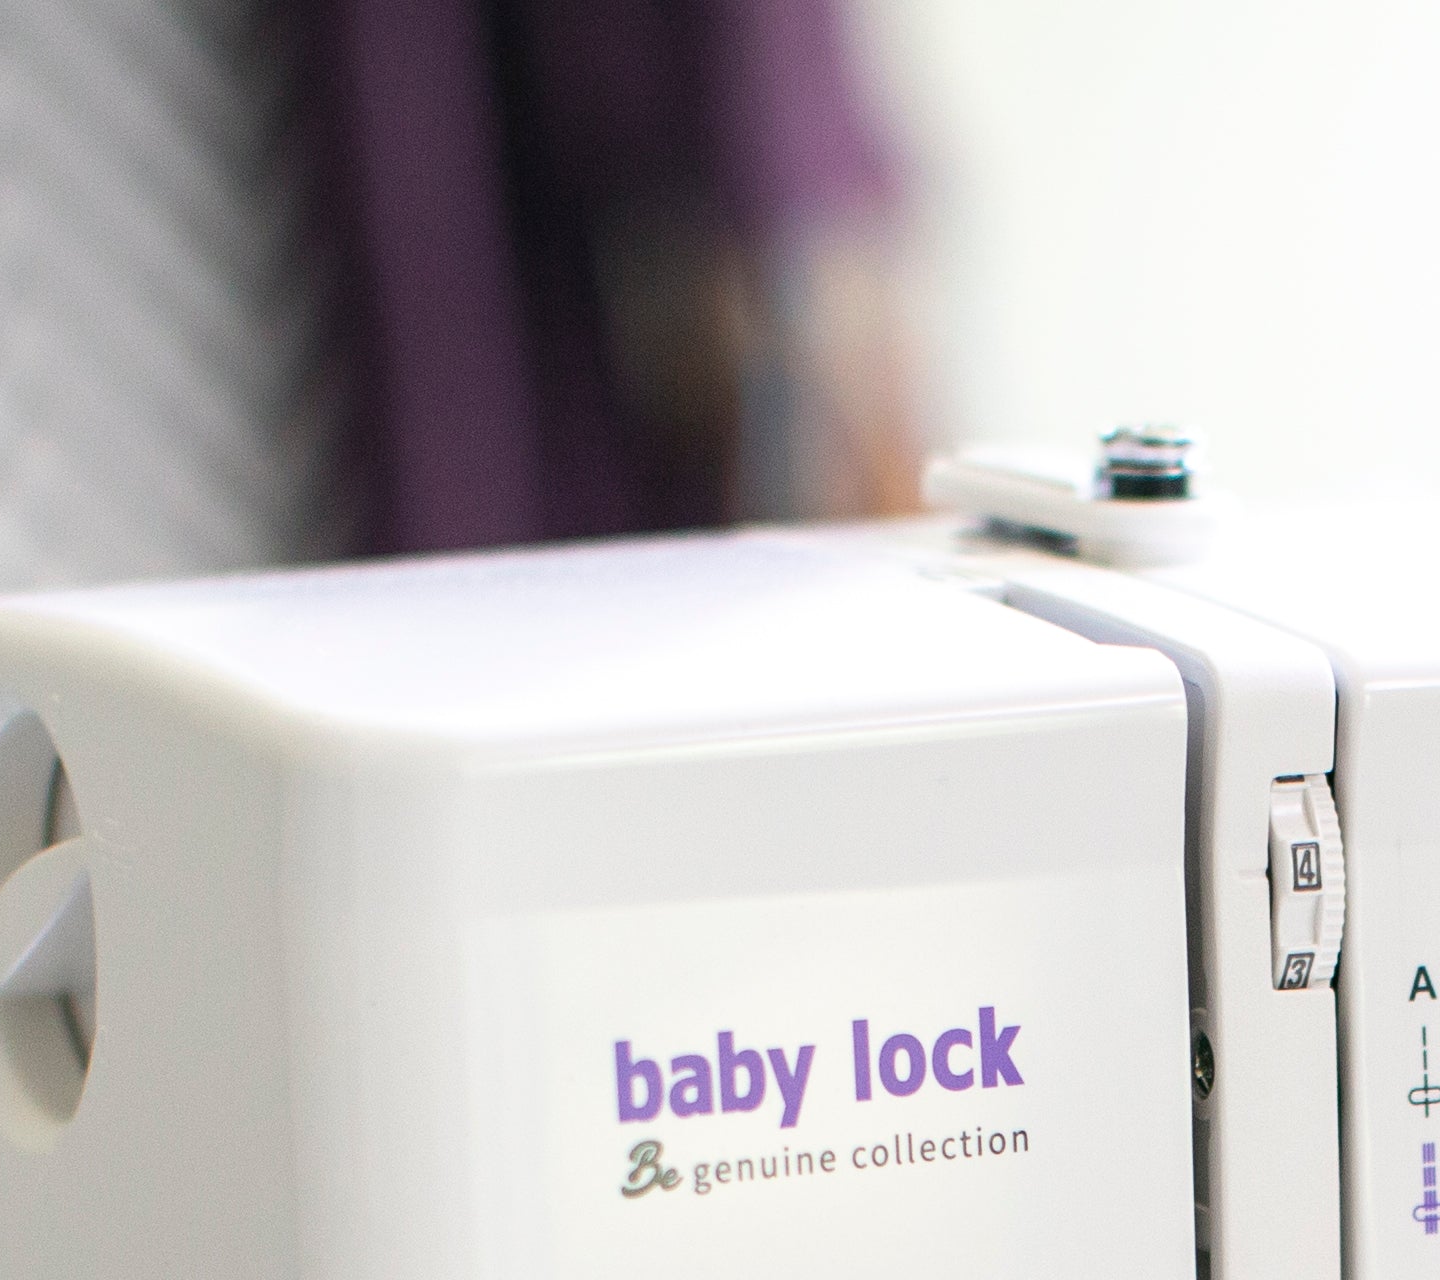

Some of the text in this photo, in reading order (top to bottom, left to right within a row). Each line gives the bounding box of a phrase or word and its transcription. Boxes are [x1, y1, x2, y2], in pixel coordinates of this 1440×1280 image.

[1298, 849, 1316, 886] 4
[1286, 958, 1307, 988] 3
[1408, 965, 1438, 1002] A
[613, 1005, 1026, 1130] baby lock
[619, 1126, 1030, 1200] Be genuine collection
